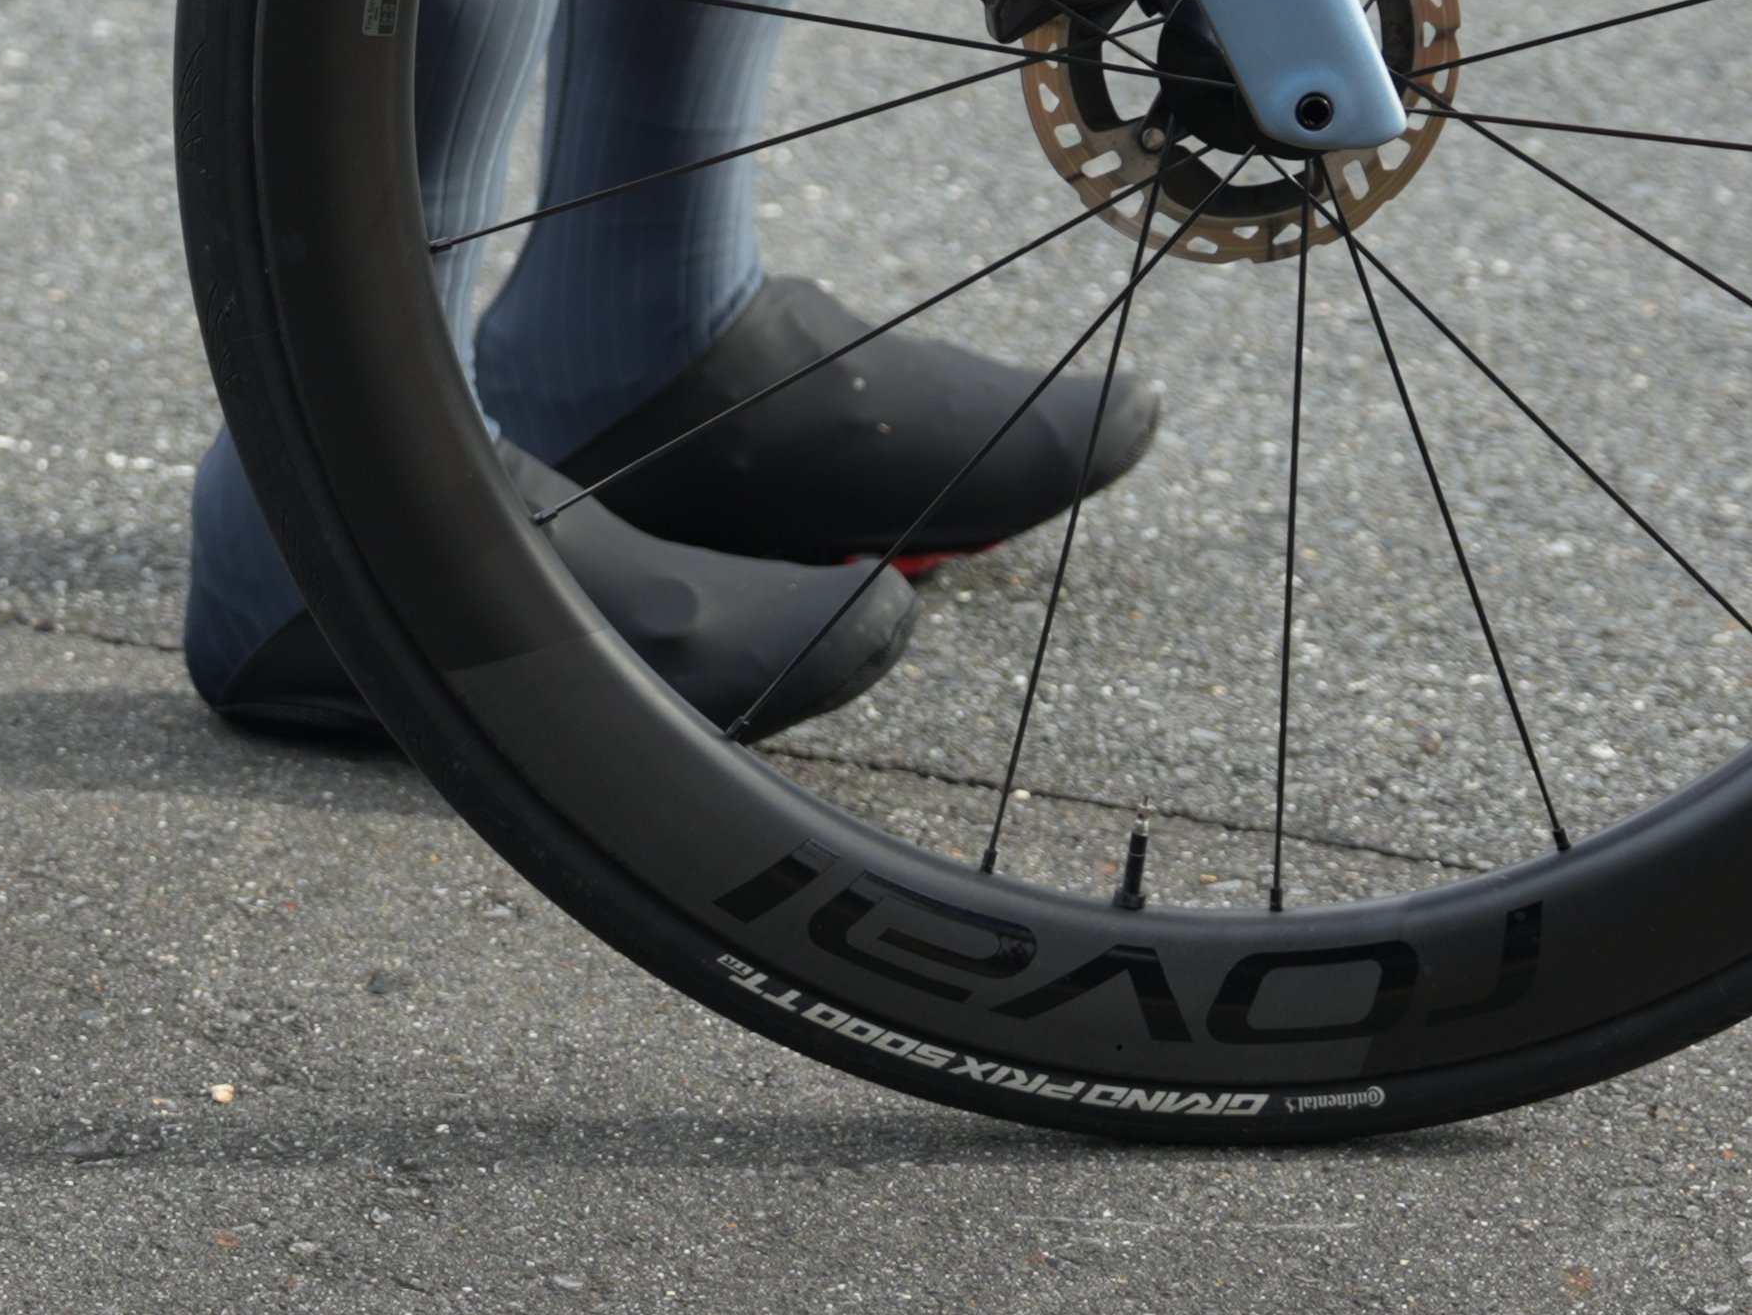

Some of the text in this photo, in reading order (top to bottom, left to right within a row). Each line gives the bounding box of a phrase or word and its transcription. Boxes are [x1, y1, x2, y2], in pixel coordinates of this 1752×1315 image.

[728, 972, 803, 1013] TT
[806, 1003, 949, 1067] 5000
[948, 1052, 1083, 1100] PRIX
[1085, 1082, 1269, 1117] GRAND
[1298, 1086, 1385, 1113] Continental
